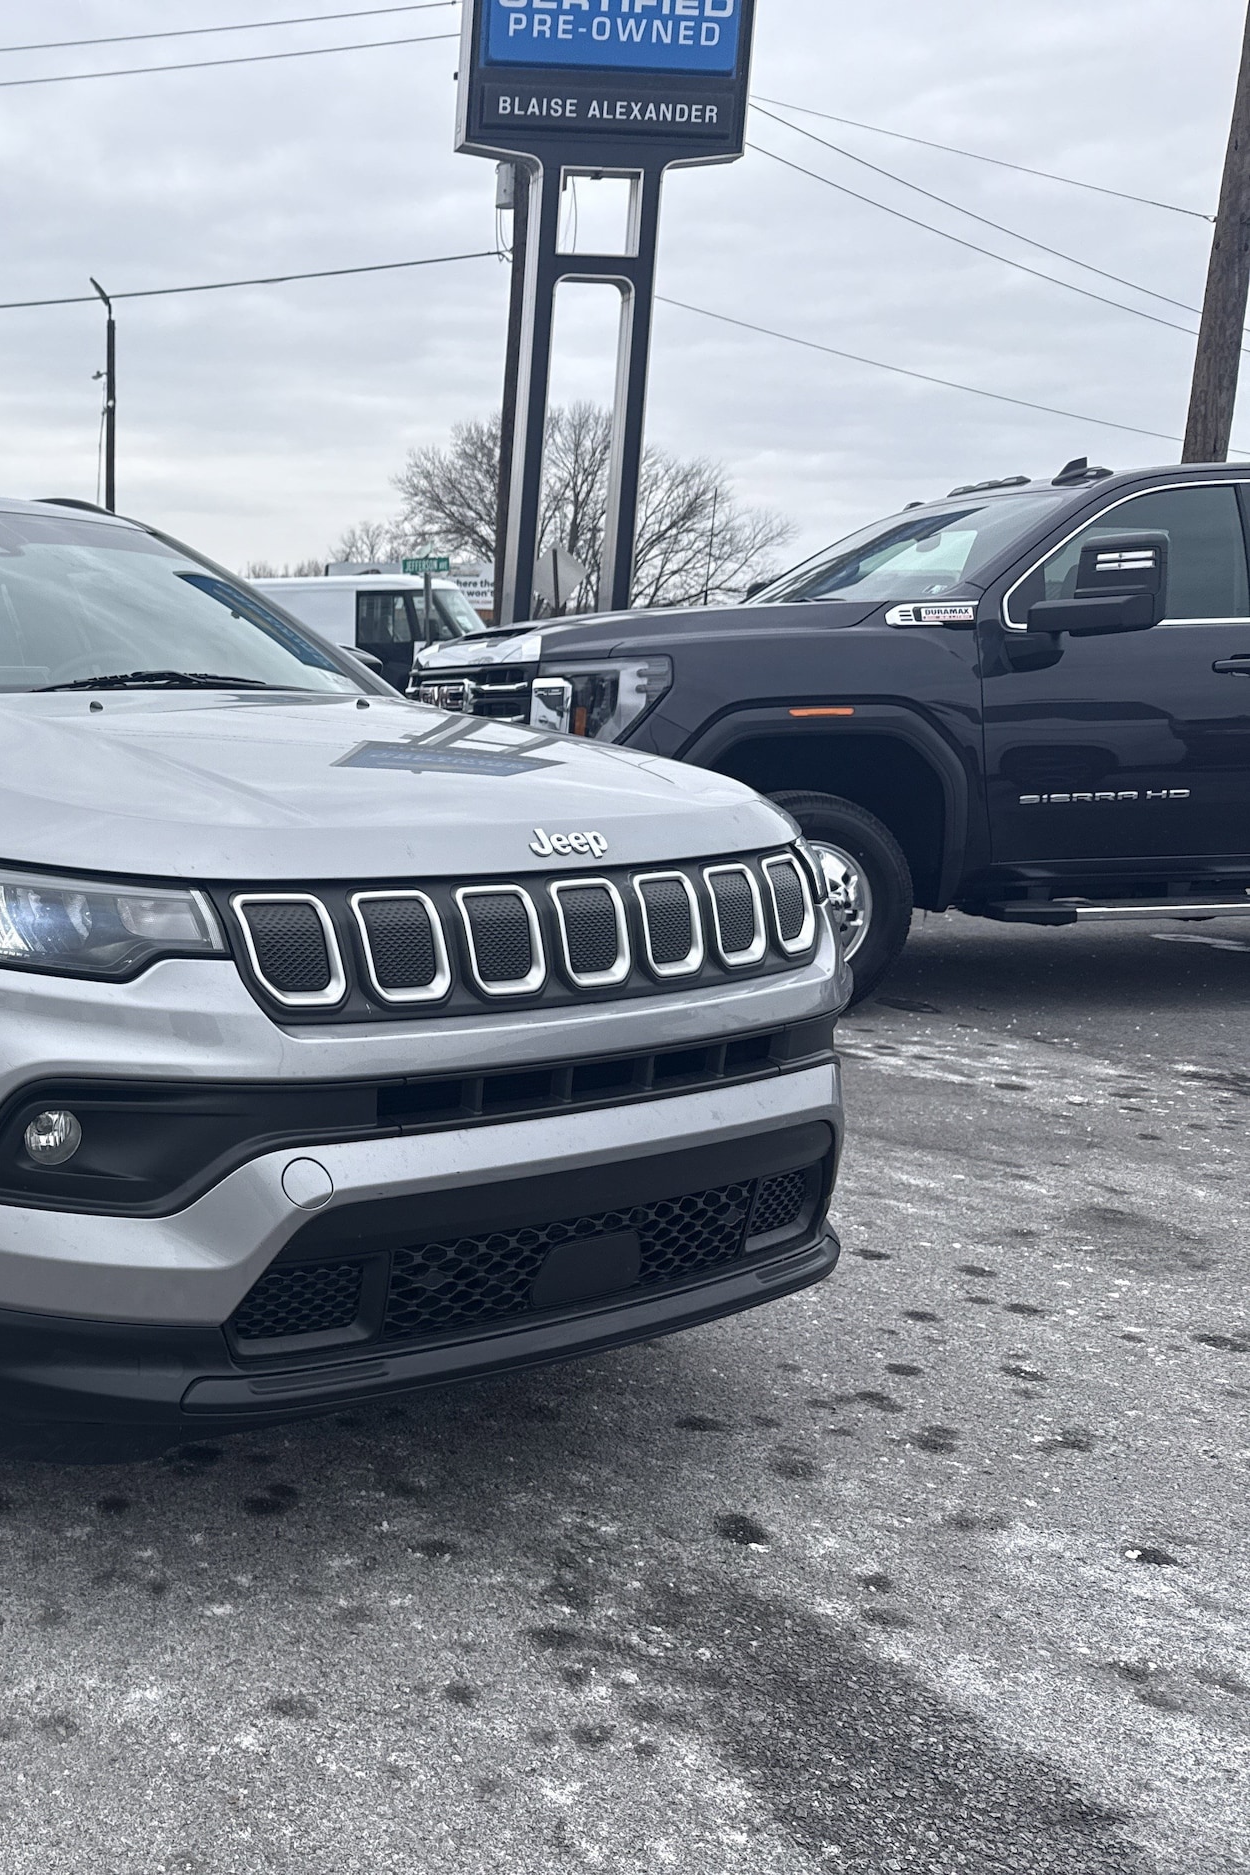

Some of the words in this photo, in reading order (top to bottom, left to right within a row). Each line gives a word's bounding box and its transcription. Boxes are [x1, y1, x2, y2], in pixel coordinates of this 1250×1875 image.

[508, 13, 720, 46] PRE-OWNED
[498, 96, 578, 117] BLAISE
[587, 100, 718, 124] ALEXANDER
[405, 560, 437, 571] JEFFERSON
[454, 579, 477, 588] here
[925, 608, 969, 616] DURAMAX
[1019, 791, 1138, 804] SIERRA
[1146, 789, 1190, 799] HD
[529, 828, 608, 858] Jeep
